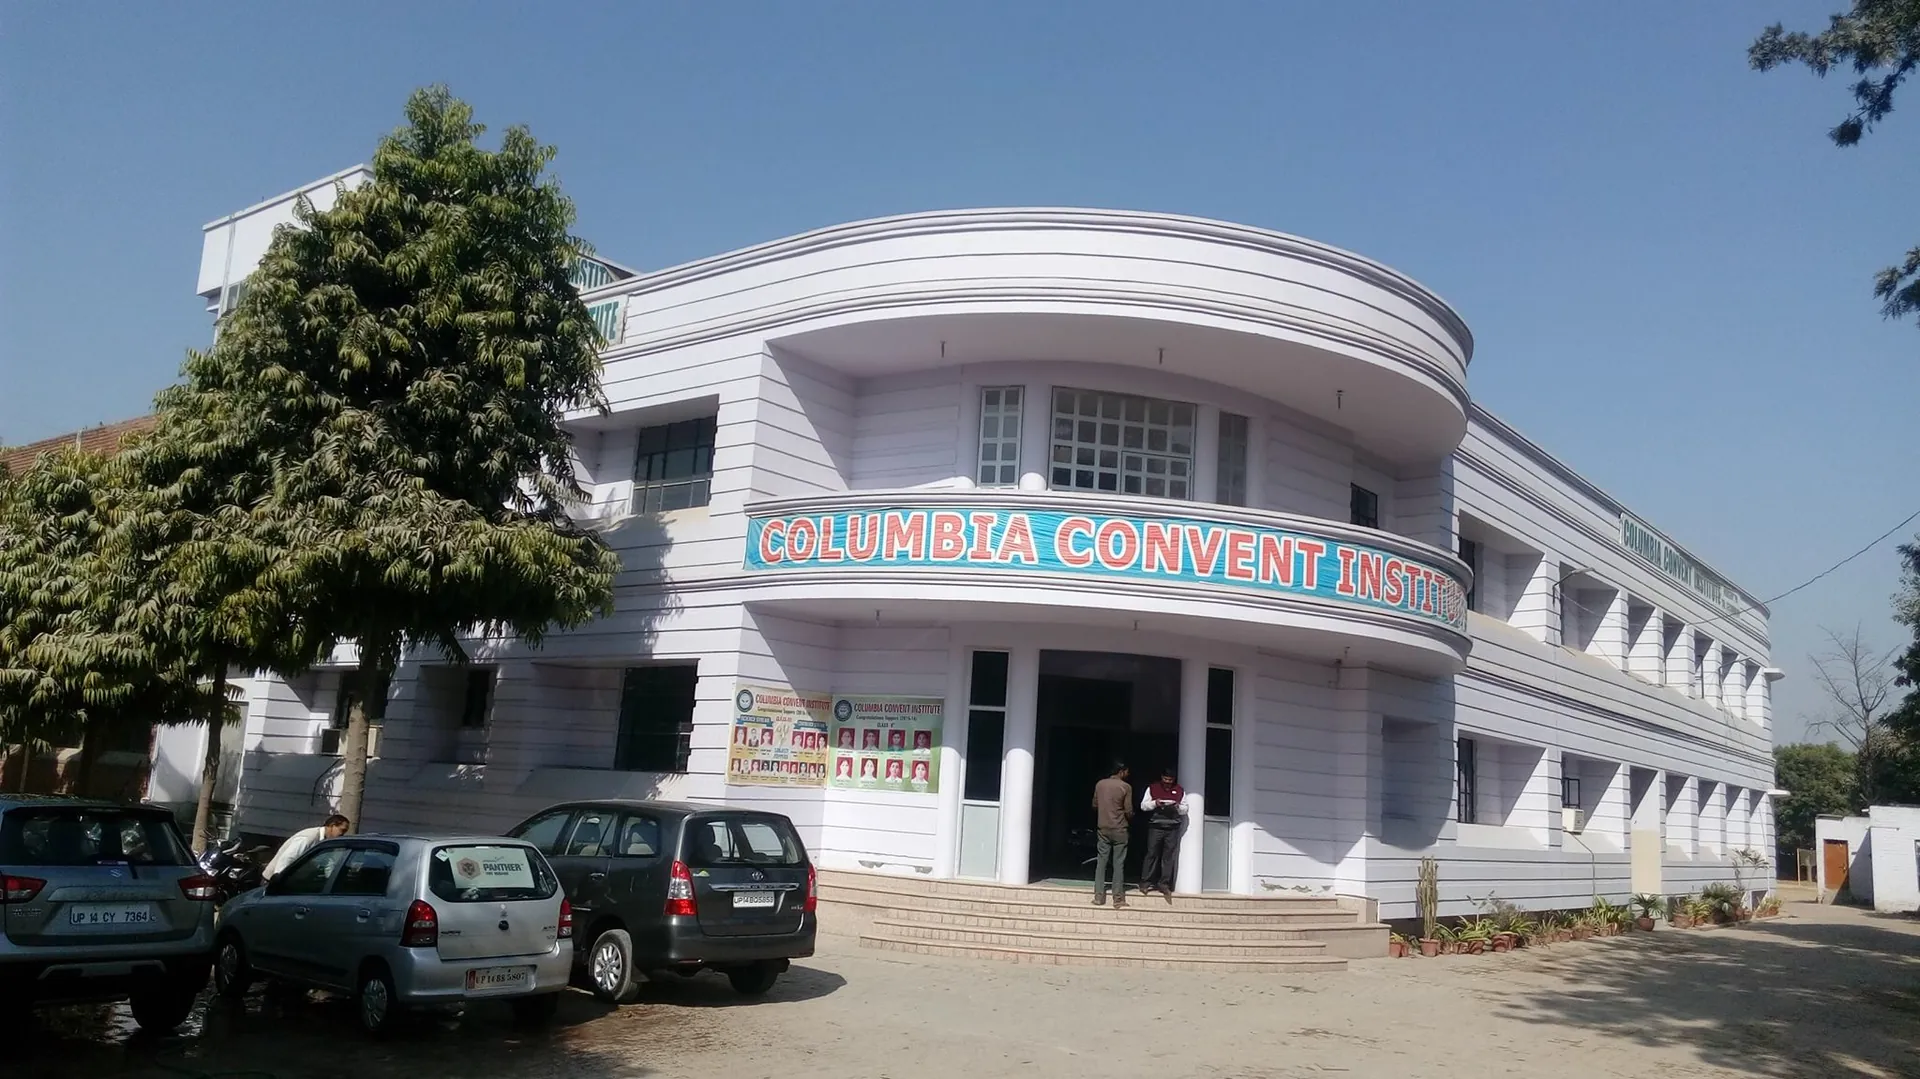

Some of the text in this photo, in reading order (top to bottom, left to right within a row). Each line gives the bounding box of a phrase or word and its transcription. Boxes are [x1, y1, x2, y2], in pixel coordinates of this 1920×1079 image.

[759, 511, 1038, 564] COLUMBIA
[1054, 515, 1326, 589] CONVENT
[1623, 518, 1662, 567] COLUMBIA
[1663, 545, 1692, 587] CONVENT
[854, 703, 941, 715] COLUMBIA CONVENT INSTITUTE
[483, 863, 522, 872] PANTHER
[72, 911, 147, 923] UP 14 CY 7364
